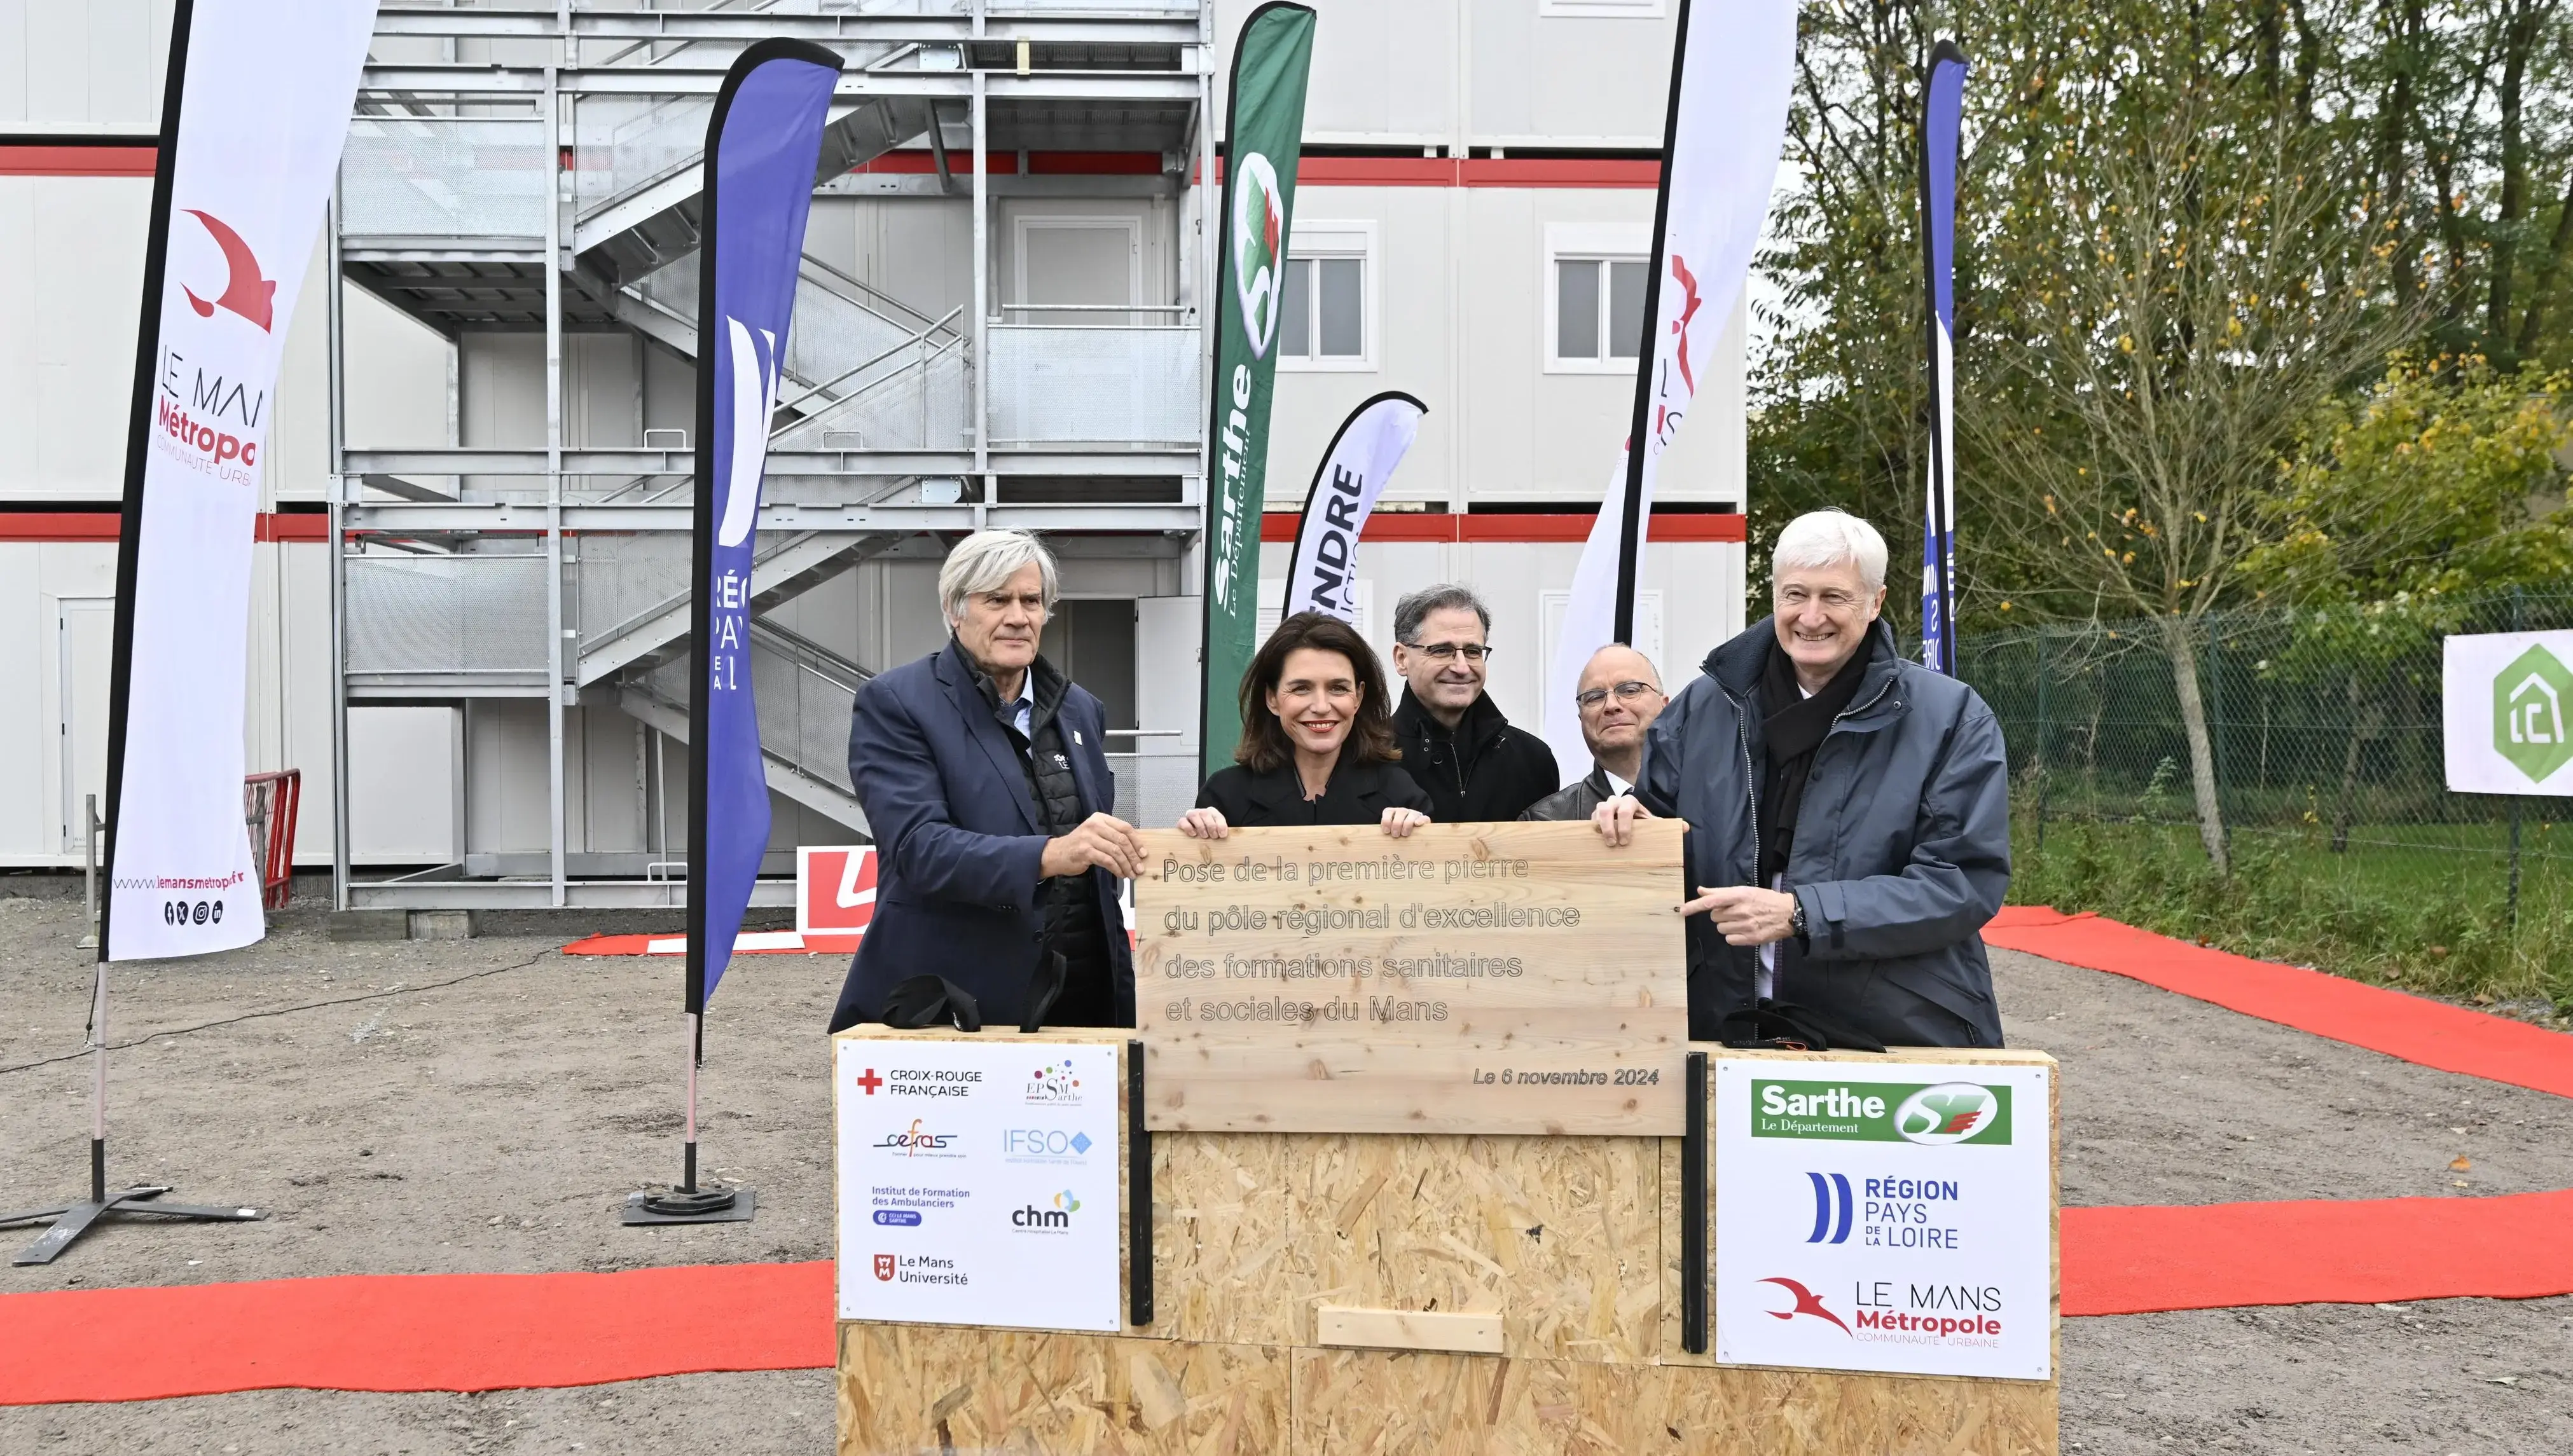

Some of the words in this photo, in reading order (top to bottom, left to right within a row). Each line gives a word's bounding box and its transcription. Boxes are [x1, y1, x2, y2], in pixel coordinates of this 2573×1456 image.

[162, 344, 183, 399] LE
[156, 434, 214, 475] COMMUNAUTÉ
[1215, 364, 1251, 612] Sarthe
[1230, 429, 1250, 582] Département
[1229, 589, 1237, 620] Le
[1163, 858, 1225, 883] Pose
[1234, 856, 1267, 882] de
[1276, 855, 1298, 881] la
[1309, 854, 1435, 886] première
[1445, 854, 1529, 885] pierre
[1164, 905, 1198, 931] du
[1208, 905, 1267, 936] pôle
[1276, 903, 1390, 936] régional
[1399, 902, 1580, 929] d'excellence
[1165, 953, 1215, 979] des
[1224, 952, 1373, 979] formations
[1383, 952, 1524, 979] sanitaires
[1165, 996, 1192, 1021] et
[1200, 996, 1315, 1022] sociales
[1323, 995, 1358, 1021] du
[1369, 995, 1449, 1022] Mans
[890, 1069, 983, 1082] CROIX-ROUGE
[1473, 1068, 1496, 1085] Le
[1501, 1068, 1513, 1085] 6
[1517, 1068, 1608, 1085] novembre
[1613, 1068, 1659, 1086] 2024
[890, 1084, 969, 1099] FRANÇAISE
[1760, 1085, 1886, 1119] Sarthe
[1761, 1118, 1777, 1131] Le
[1781, 1118, 1859, 1135] Département
[1004, 1129, 1068, 1154] IFSO
[872, 1186, 906, 1195] Institut
[908, 1187, 920, 1196] de
[923, 1188, 970, 1198] Formation
[1865, 1175, 1958, 1200] RÉGION
[872, 1197, 889, 1205] des
[891, 1197, 955, 1208] Ambulanciers
[1865, 1202, 1928, 1224] PAYS
[1012, 1204, 1068, 1228] chm
[1865, 1226, 1880, 1235] DE
[1865, 1237, 1880, 1246] LA
[1888, 1227, 1958, 1249] LOIRE
[899, 1254, 915, 1267] Le
[919, 1256, 954, 1268] Mans
[899, 1270, 968, 1286] Université
[1856, 1281, 1892, 1307] LE
[1910, 1283, 2002, 1312] MANS
[1856, 1310, 2002, 1338] Métropole
[1856, 1332, 1940, 1346] COMMUNAUTÉ
[1947, 1336, 1999, 1349] URBAINE
